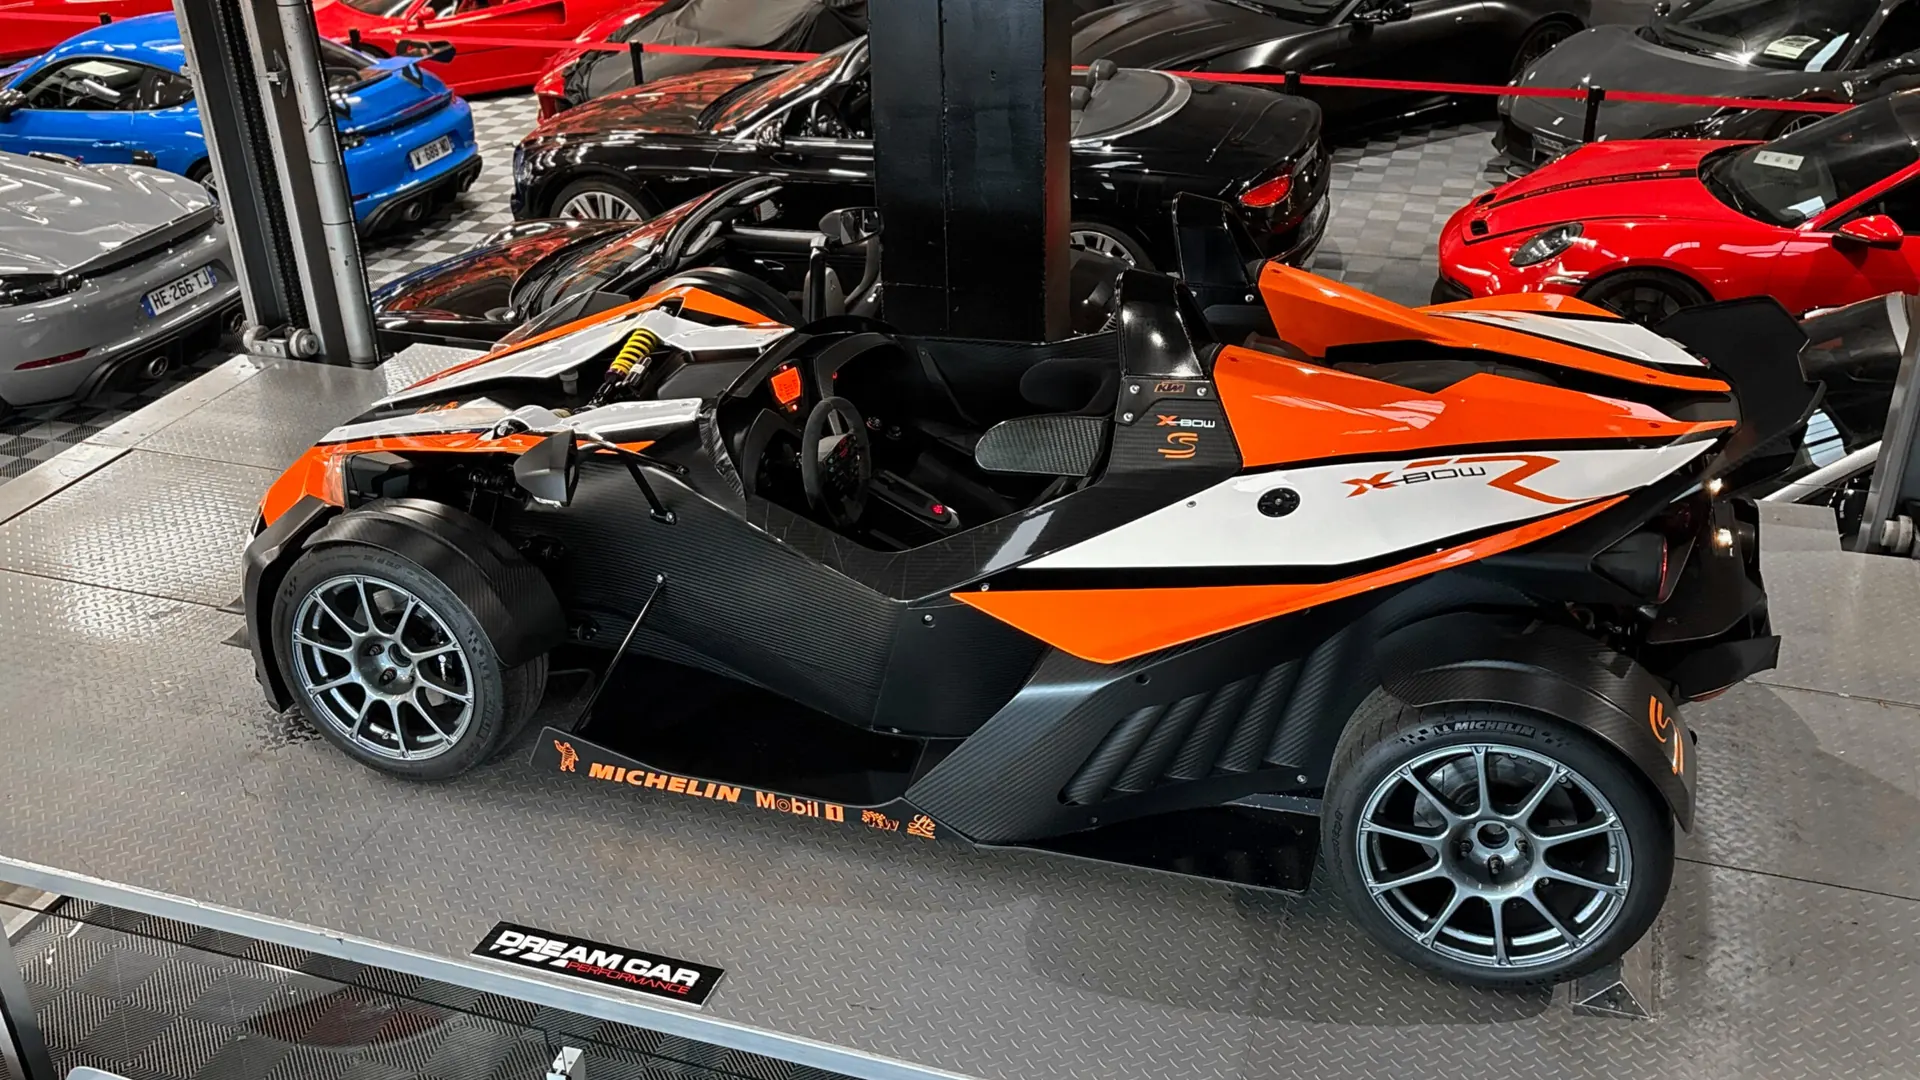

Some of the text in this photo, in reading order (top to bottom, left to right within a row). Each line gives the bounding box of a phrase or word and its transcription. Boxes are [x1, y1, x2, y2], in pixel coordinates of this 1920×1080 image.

[150, 270, 210, 310] HE-266-TJ
[1155, 382, 1185, 393] KTM
[1454, 720, 1535, 736] MICHELIN
[588, 762, 742, 803] MICHELIN
[755, 790, 819, 818] Mobil
[494, 930, 701, 987] DREAM CAR
[565, 960, 691, 995] PERFORMANCE
